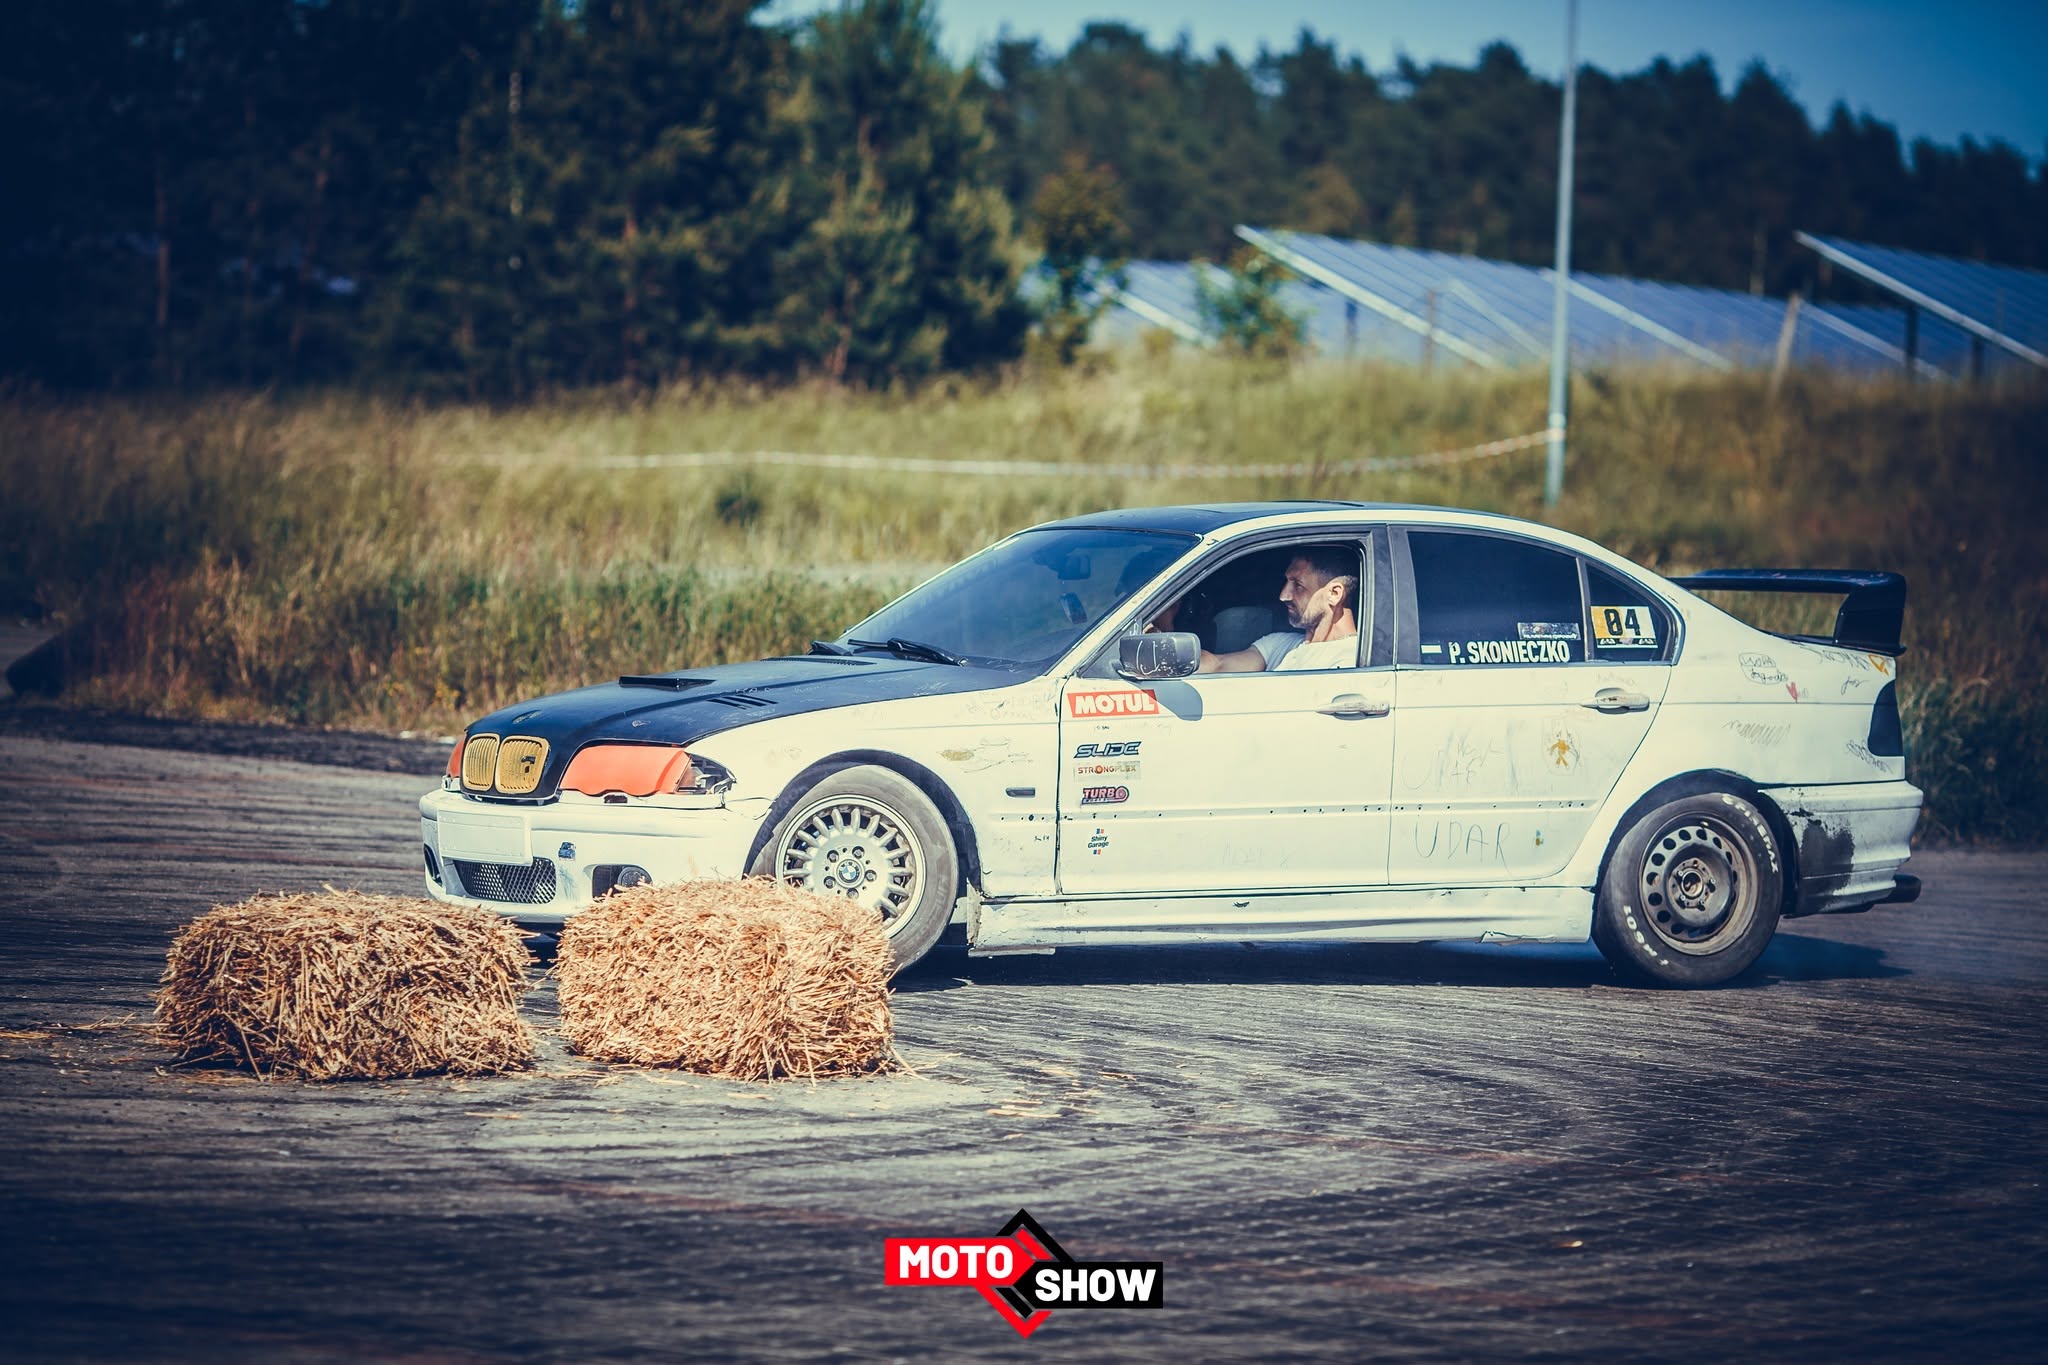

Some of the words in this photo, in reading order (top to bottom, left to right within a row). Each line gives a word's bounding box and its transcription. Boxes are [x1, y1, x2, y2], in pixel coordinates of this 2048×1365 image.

[1604, 608, 1642, 636] 04
[1448, 641, 1465, 664] P.
[1466, 640, 1570, 663] SKONIECZKO
[1074, 692, 1155, 715] MOTUL
[1073, 741, 1142, 758] SLIDE
[1082, 786, 1130, 802] TURBO
[1087, 840, 1110, 849] Garage
[1091, 835, 1108, 843] Shiny
